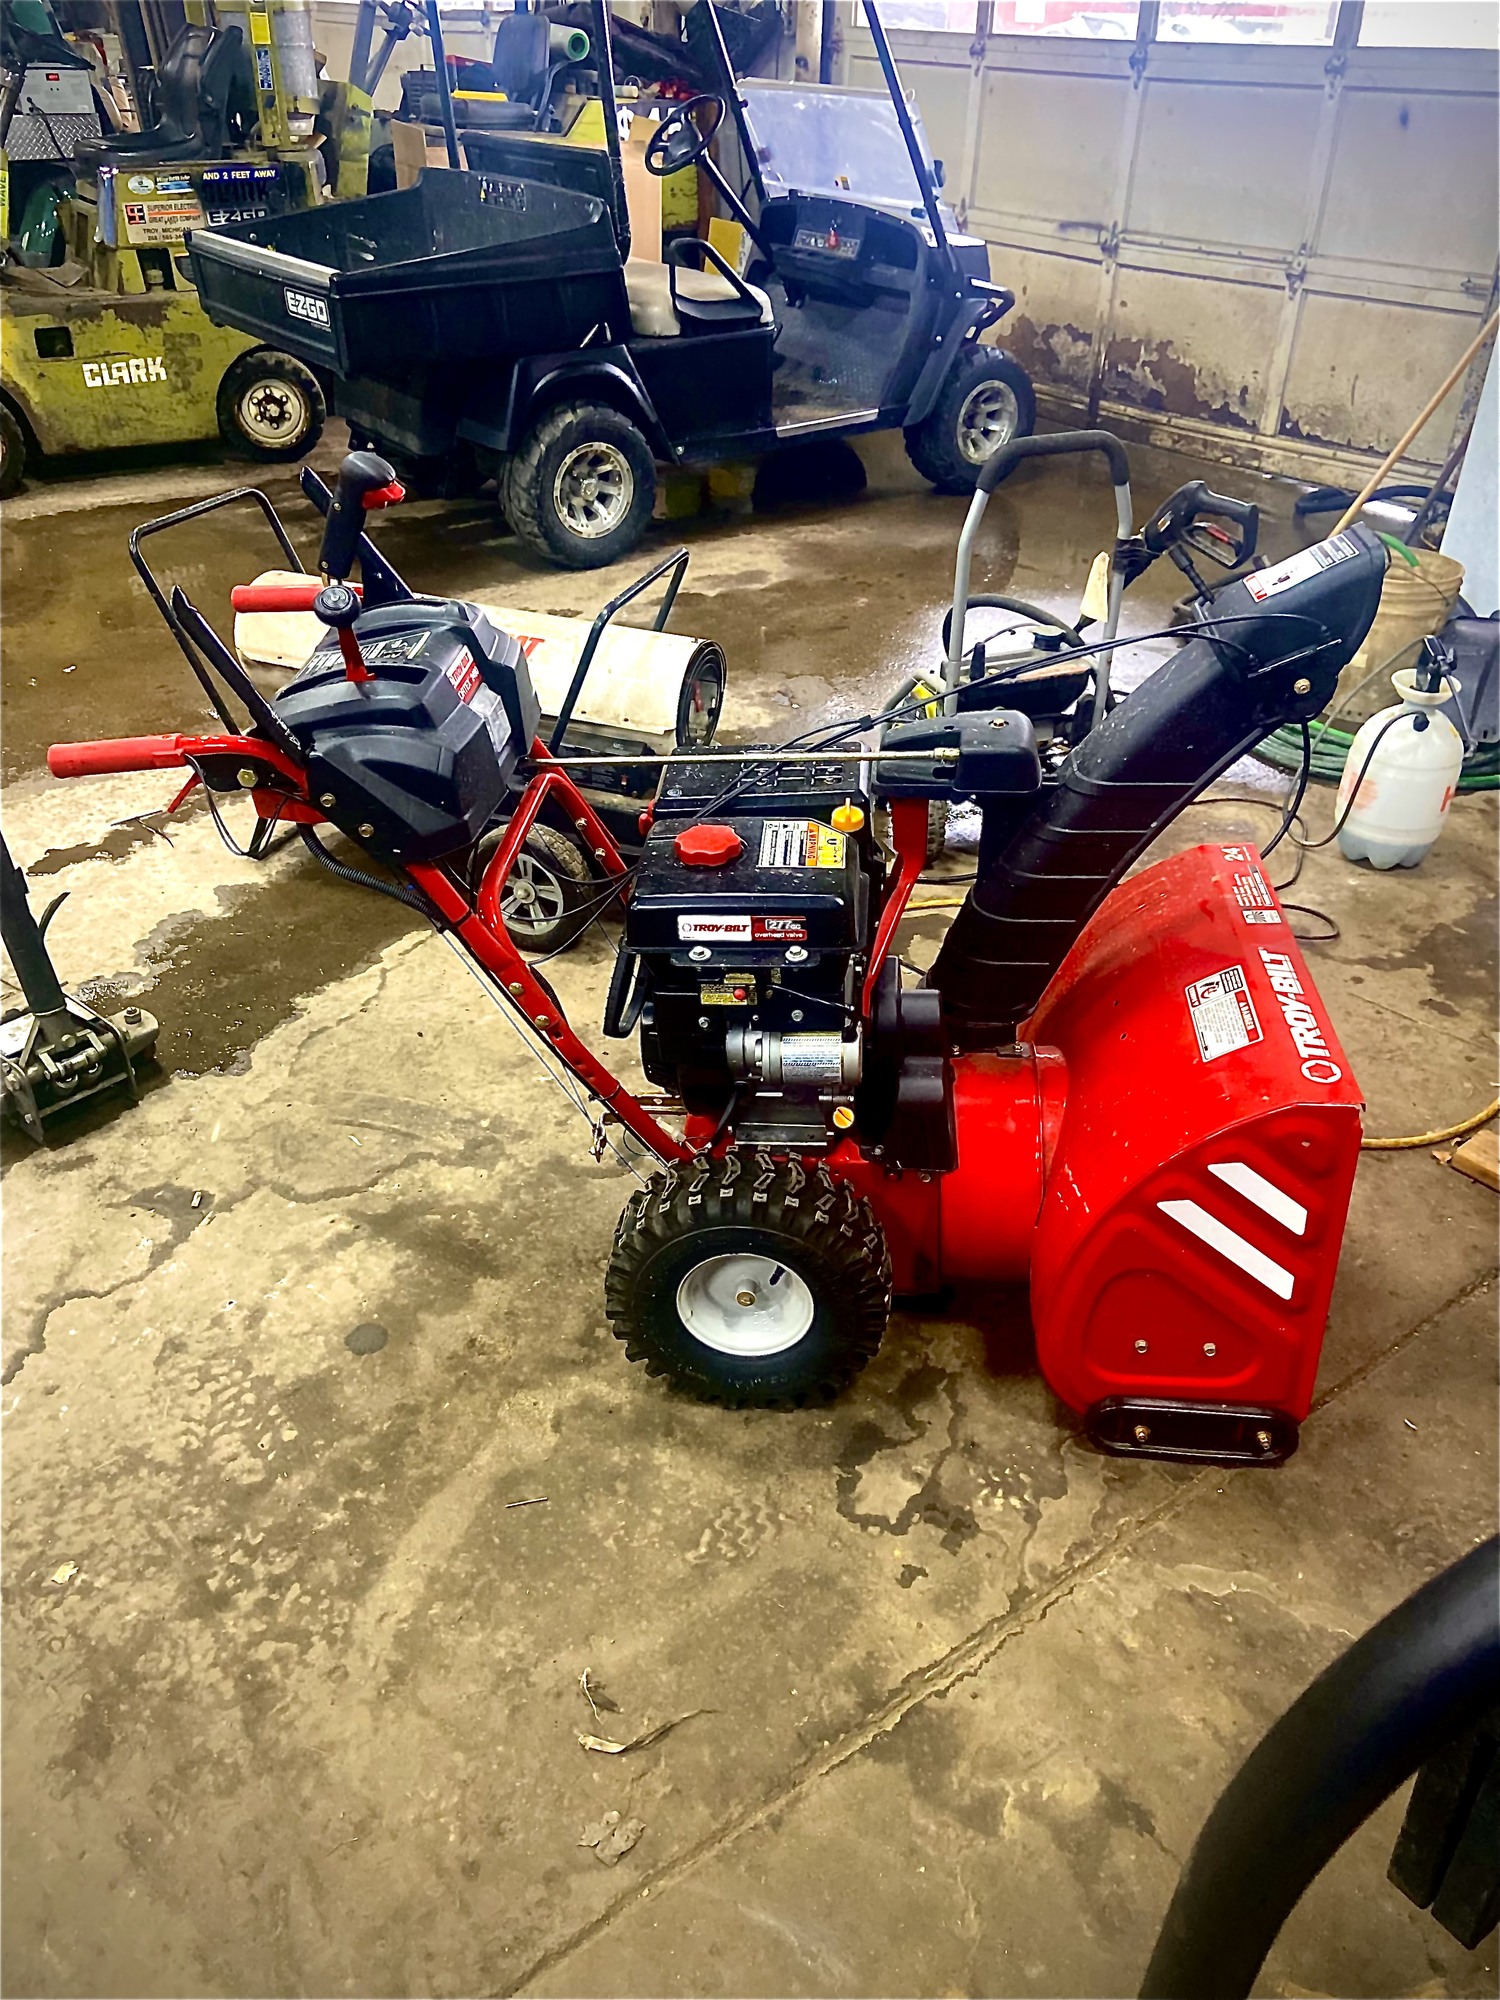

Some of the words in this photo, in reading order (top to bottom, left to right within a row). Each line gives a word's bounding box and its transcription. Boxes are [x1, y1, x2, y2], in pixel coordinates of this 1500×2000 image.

[203, 172, 220, 181] AND
[222, 171, 229, 180] 2
[231, 170, 251, 180] FEET
[254, 169, 276, 178] AWAY
[147, 204, 173, 212] SUPERIOR
[286, 290, 328, 322] EZGO
[82, 356, 168, 388] CLARK
[1223, 846, 1244, 862] 24
[692, 923, 750, 933] TROY-BILT
[768, 920, 802, 930] 277cc
[754, 931, 785, 939] overhead
[1257, 947, 1331, 1059] TROY-BILT
